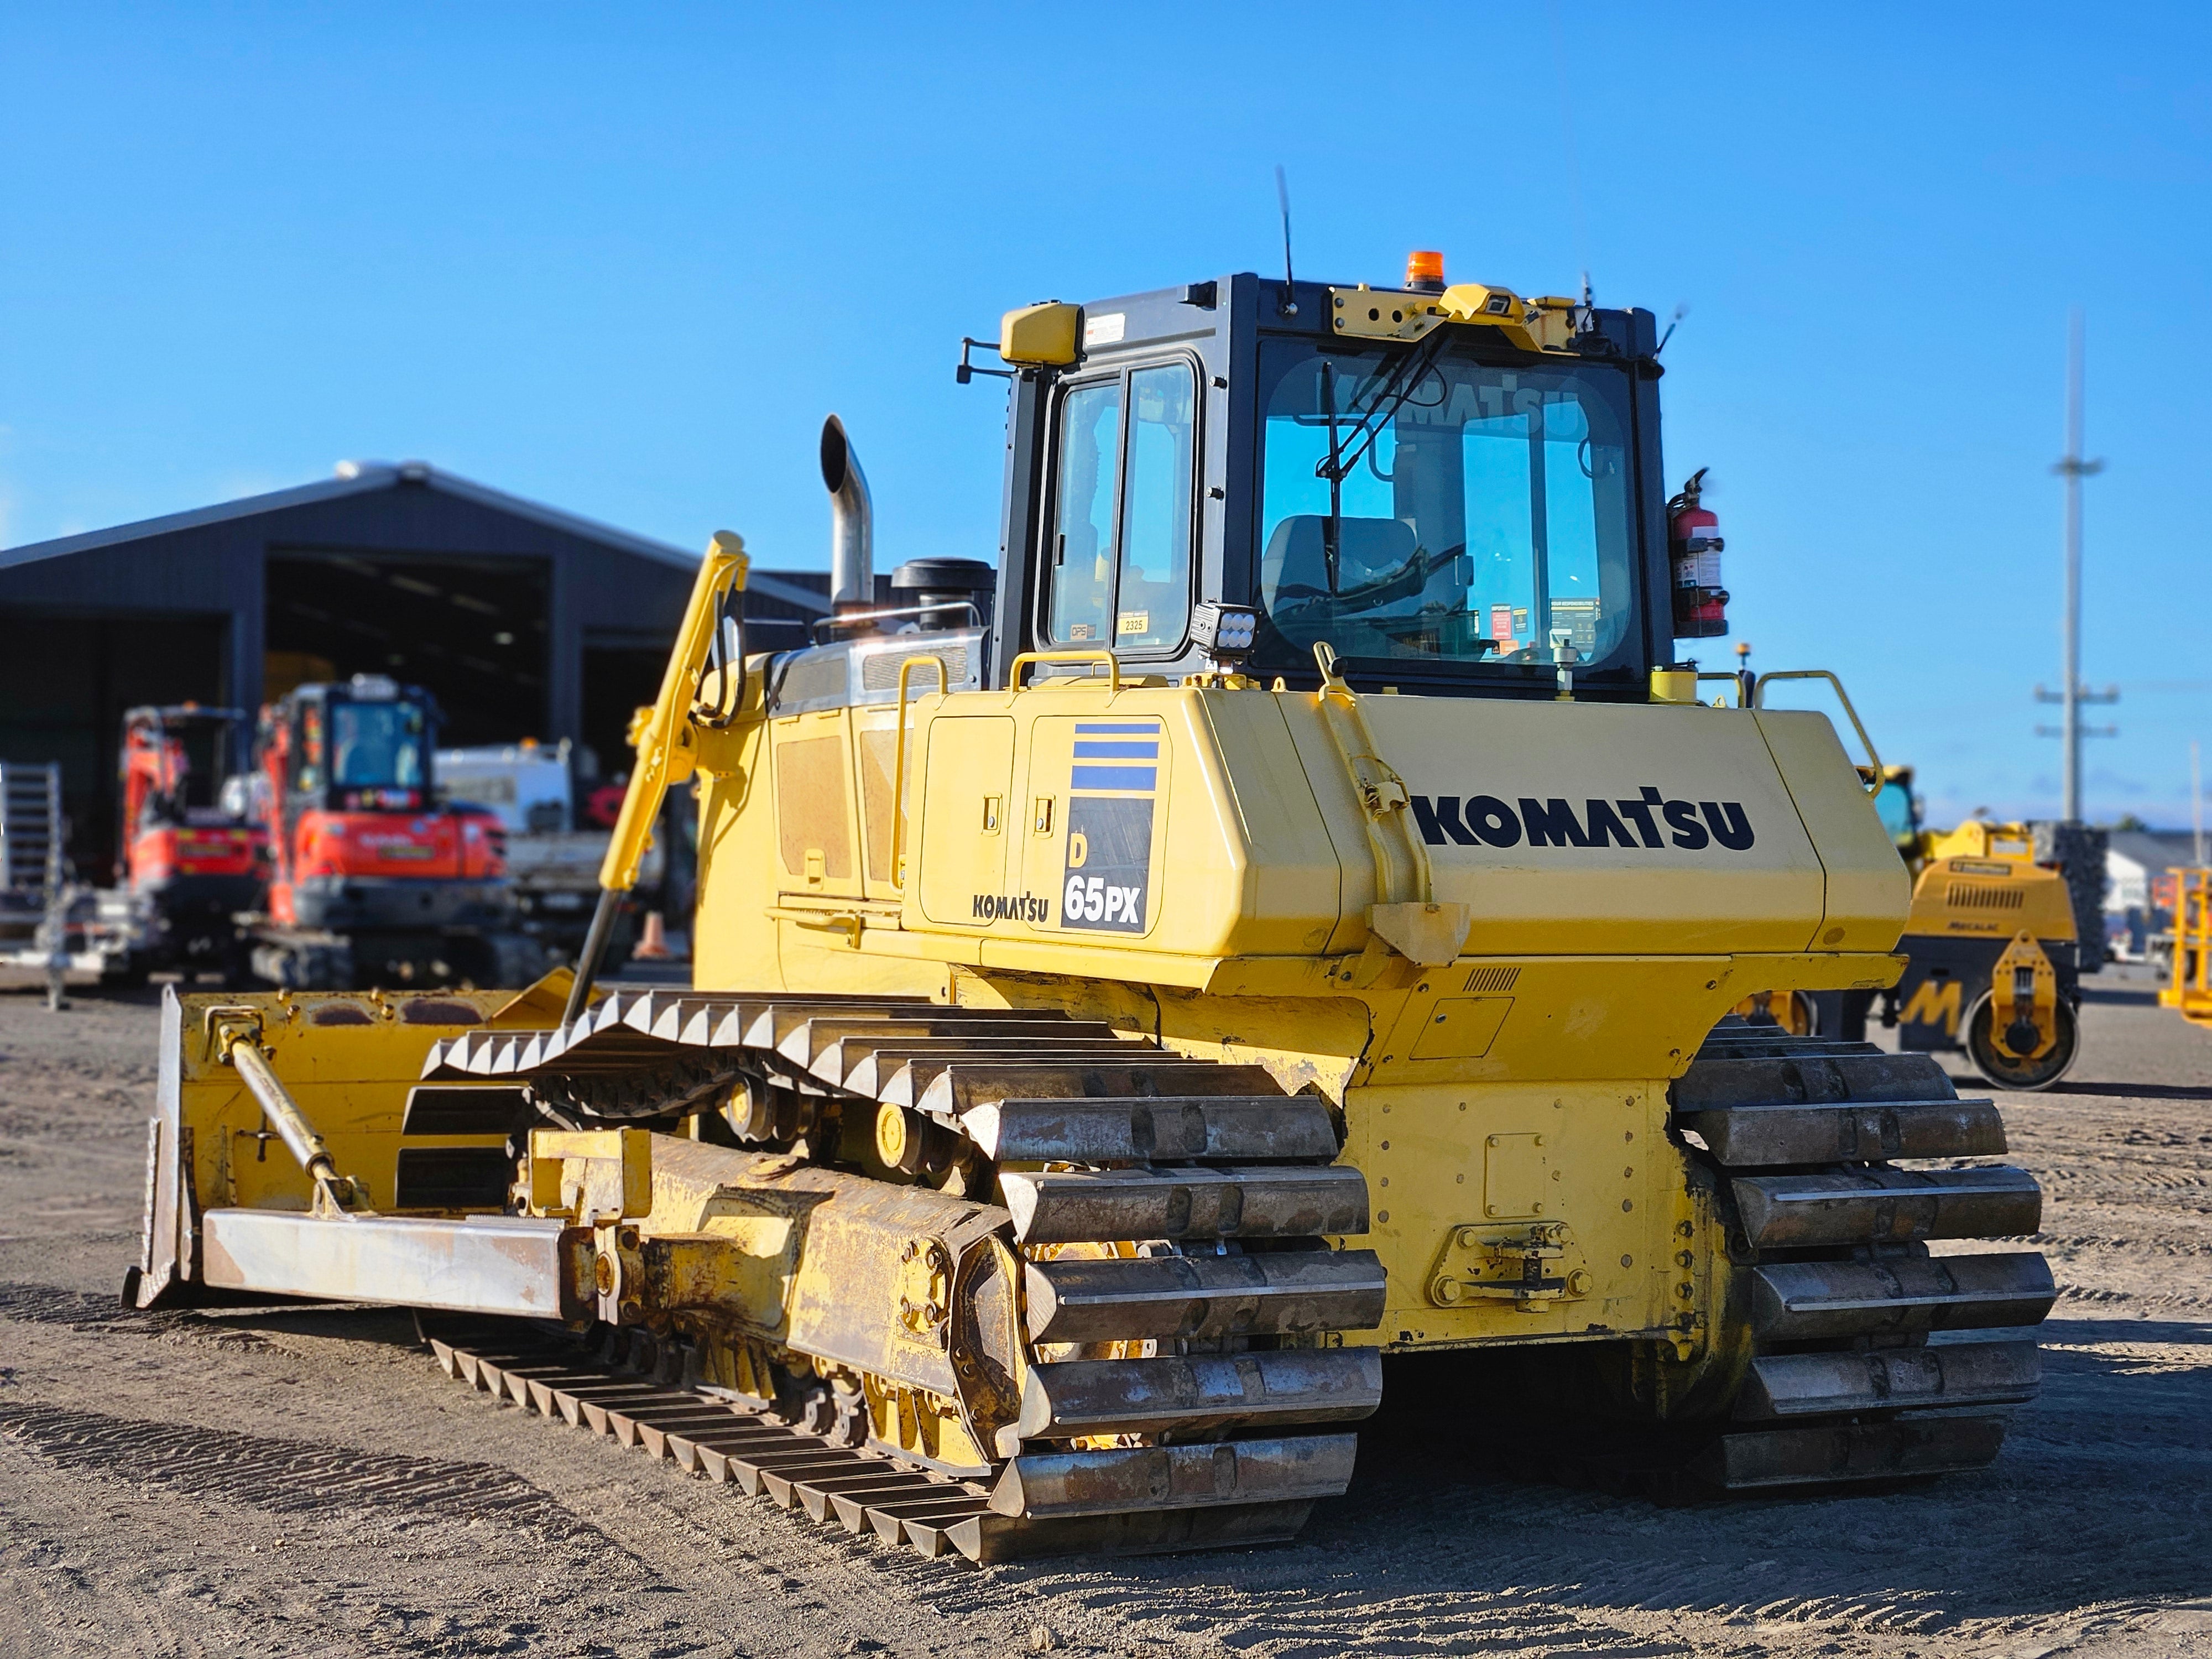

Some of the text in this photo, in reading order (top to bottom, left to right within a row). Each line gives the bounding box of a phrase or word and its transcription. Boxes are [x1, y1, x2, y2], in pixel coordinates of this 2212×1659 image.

[1316, 374, 1579, 435] KOMATSU
[1126, 620, 1142, 630] 2325
[1410, 786, 1755, 851] KOMATSU
[1068, 833, 1088, 868] D
[972, 891, 1048, 922] KOMATSU
[1064, 874, 1141, 924] 65PX
